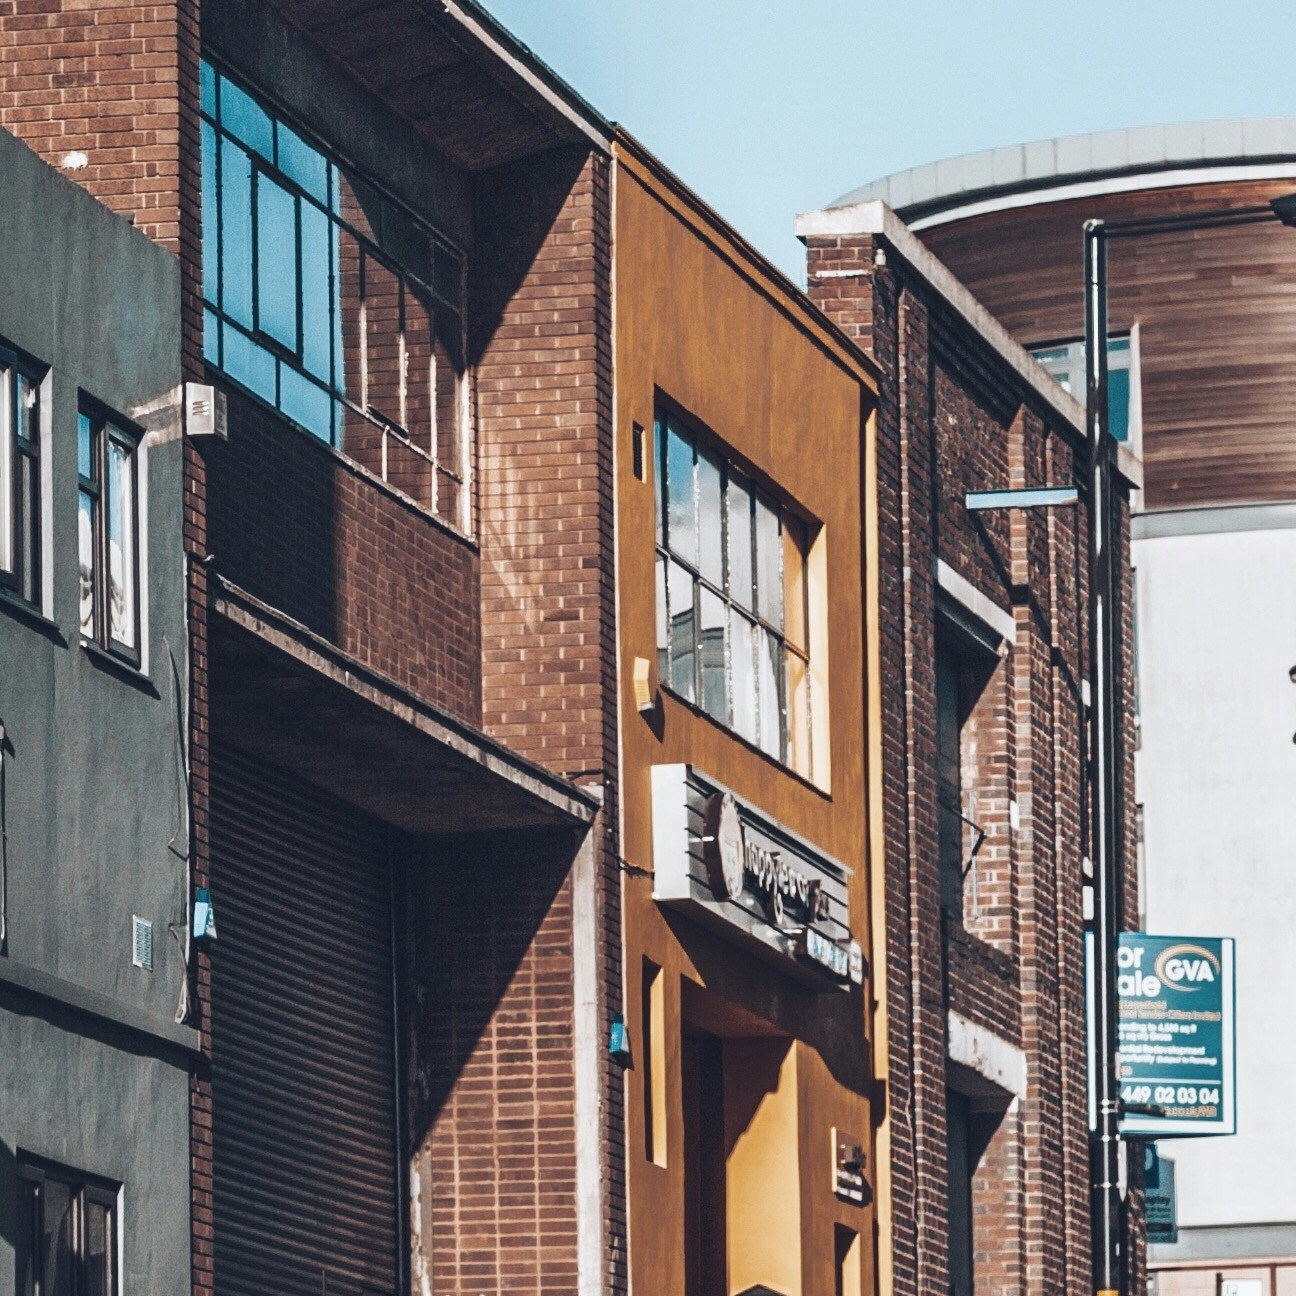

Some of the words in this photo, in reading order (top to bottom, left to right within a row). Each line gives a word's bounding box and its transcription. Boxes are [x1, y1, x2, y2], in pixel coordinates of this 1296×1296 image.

[1117, 946, 1145, 968] or
[1164, 958, 1215, 982] GVA
[1117, 970, 1162, 997] ale
[1120, 1085, 1152, 1103] 449
[1154, 1086, 1176, 1104] 02
[1177, 1086, 1198, 1105] 03
[1198, 1087, 1220, 1105] 04
